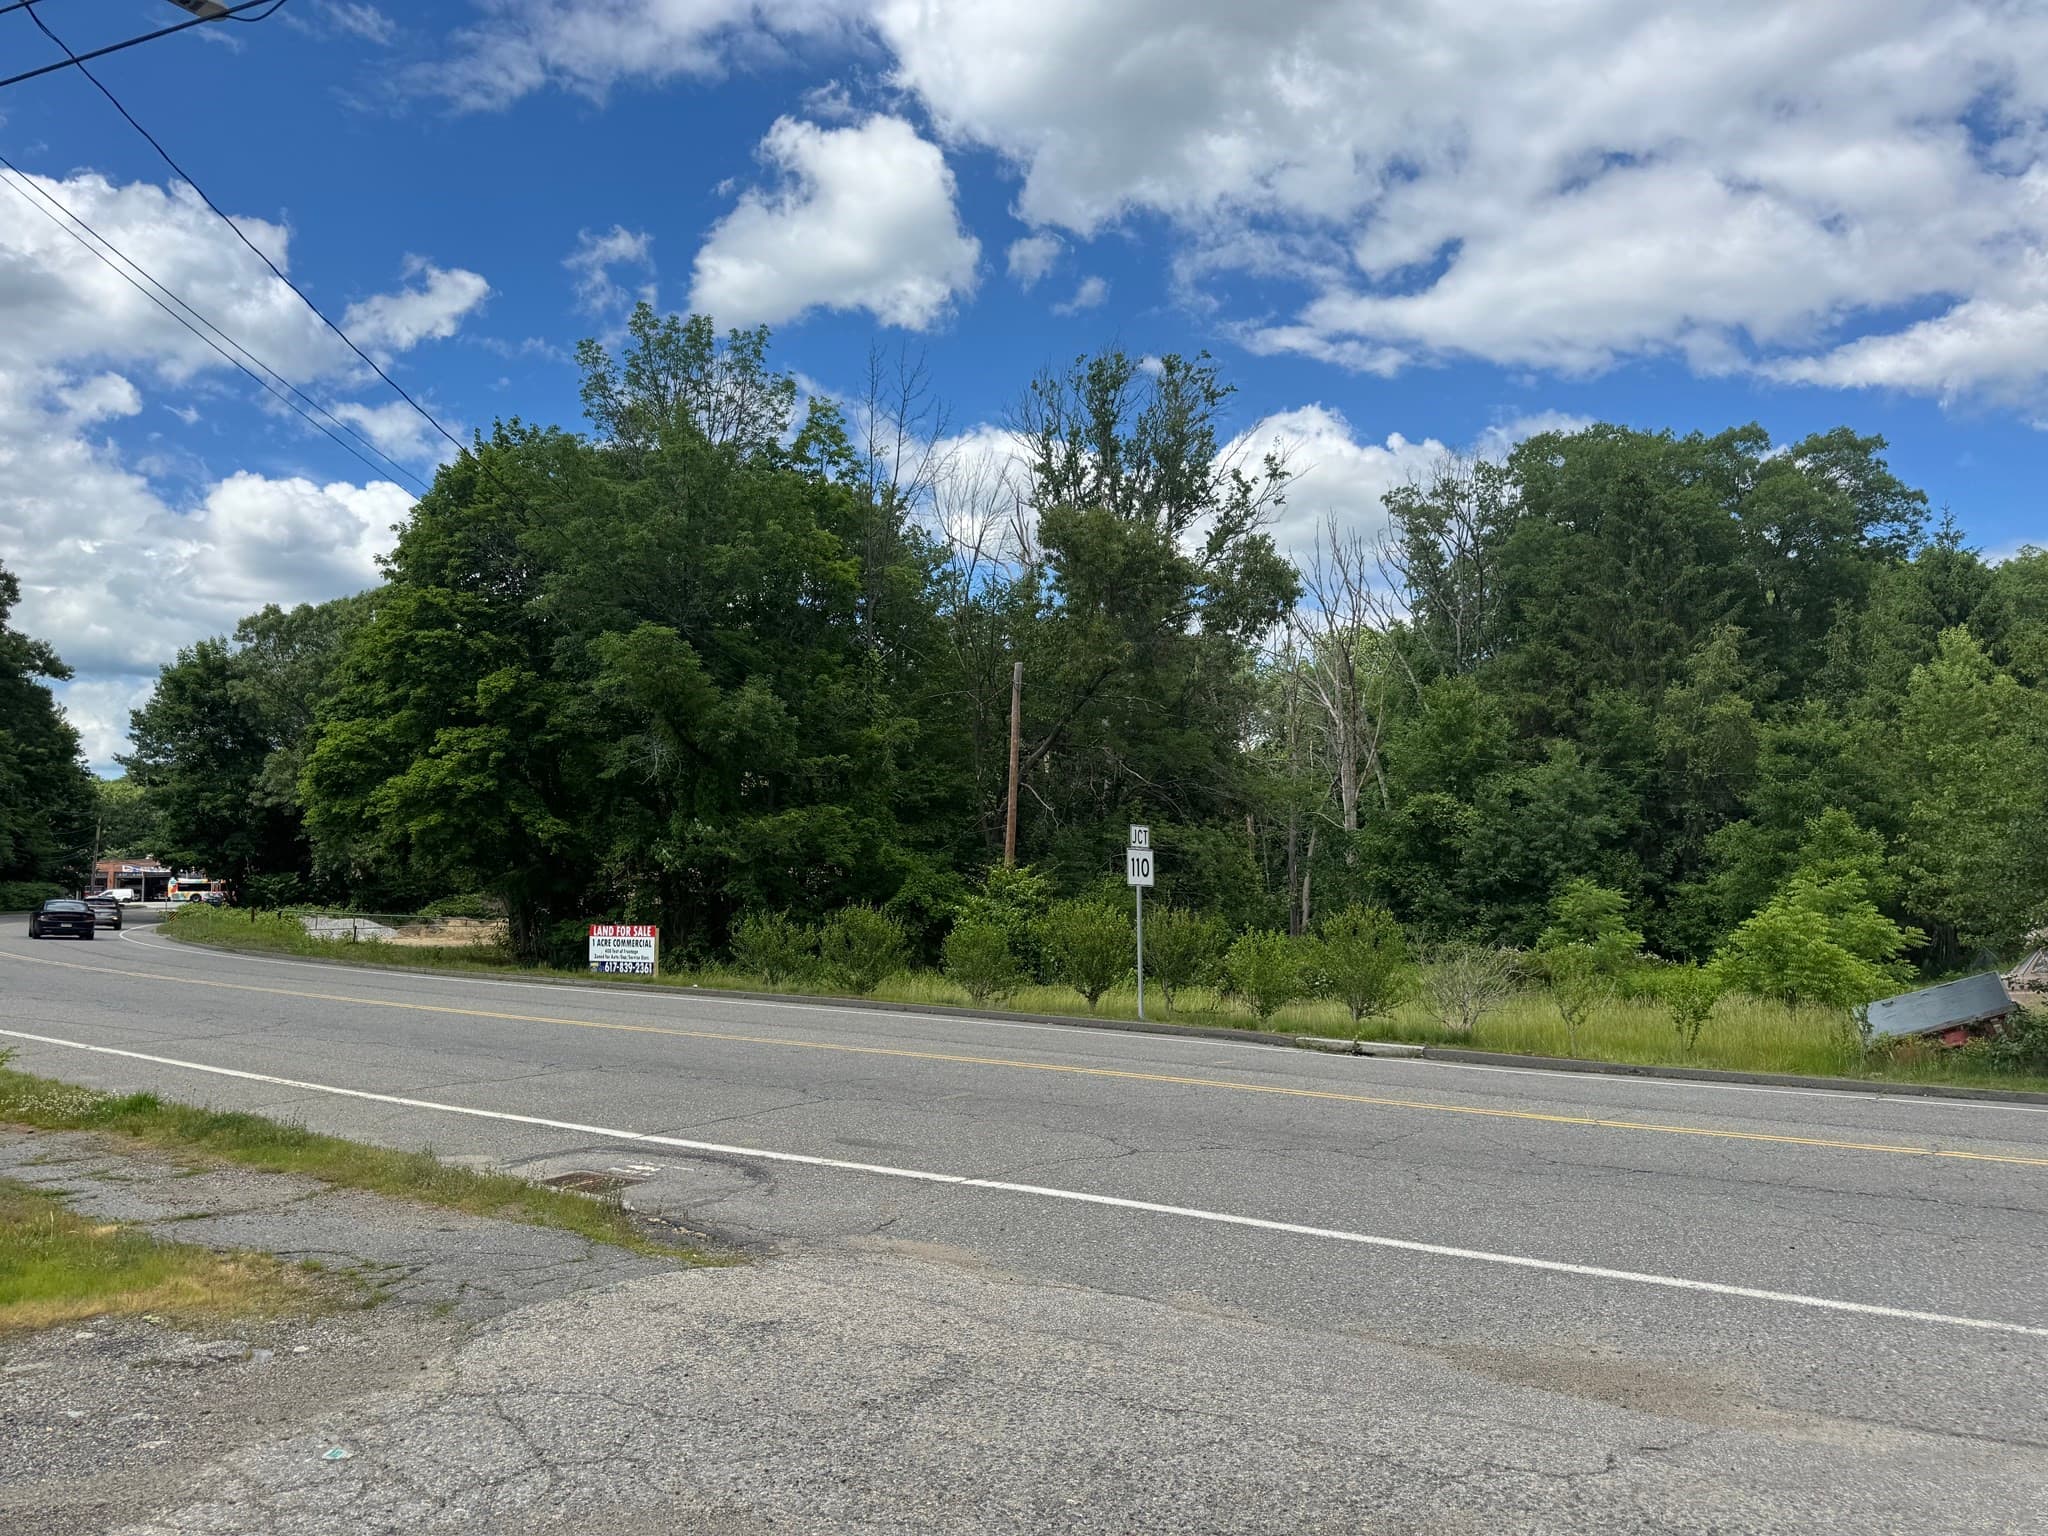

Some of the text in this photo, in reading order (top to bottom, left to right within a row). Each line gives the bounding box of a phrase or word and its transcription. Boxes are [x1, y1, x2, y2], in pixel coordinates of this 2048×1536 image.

[1132, 829, 1148, 845] JCT
[1131, 857, 1150, 878] 110
[593, 925, 652, 937] LAND FOR SALE
[597, 938, 612, 947] ACRE
[612, 938, 652, 948] COMMERCIAL
[604, 961, 652, 974] 617-839-2361
